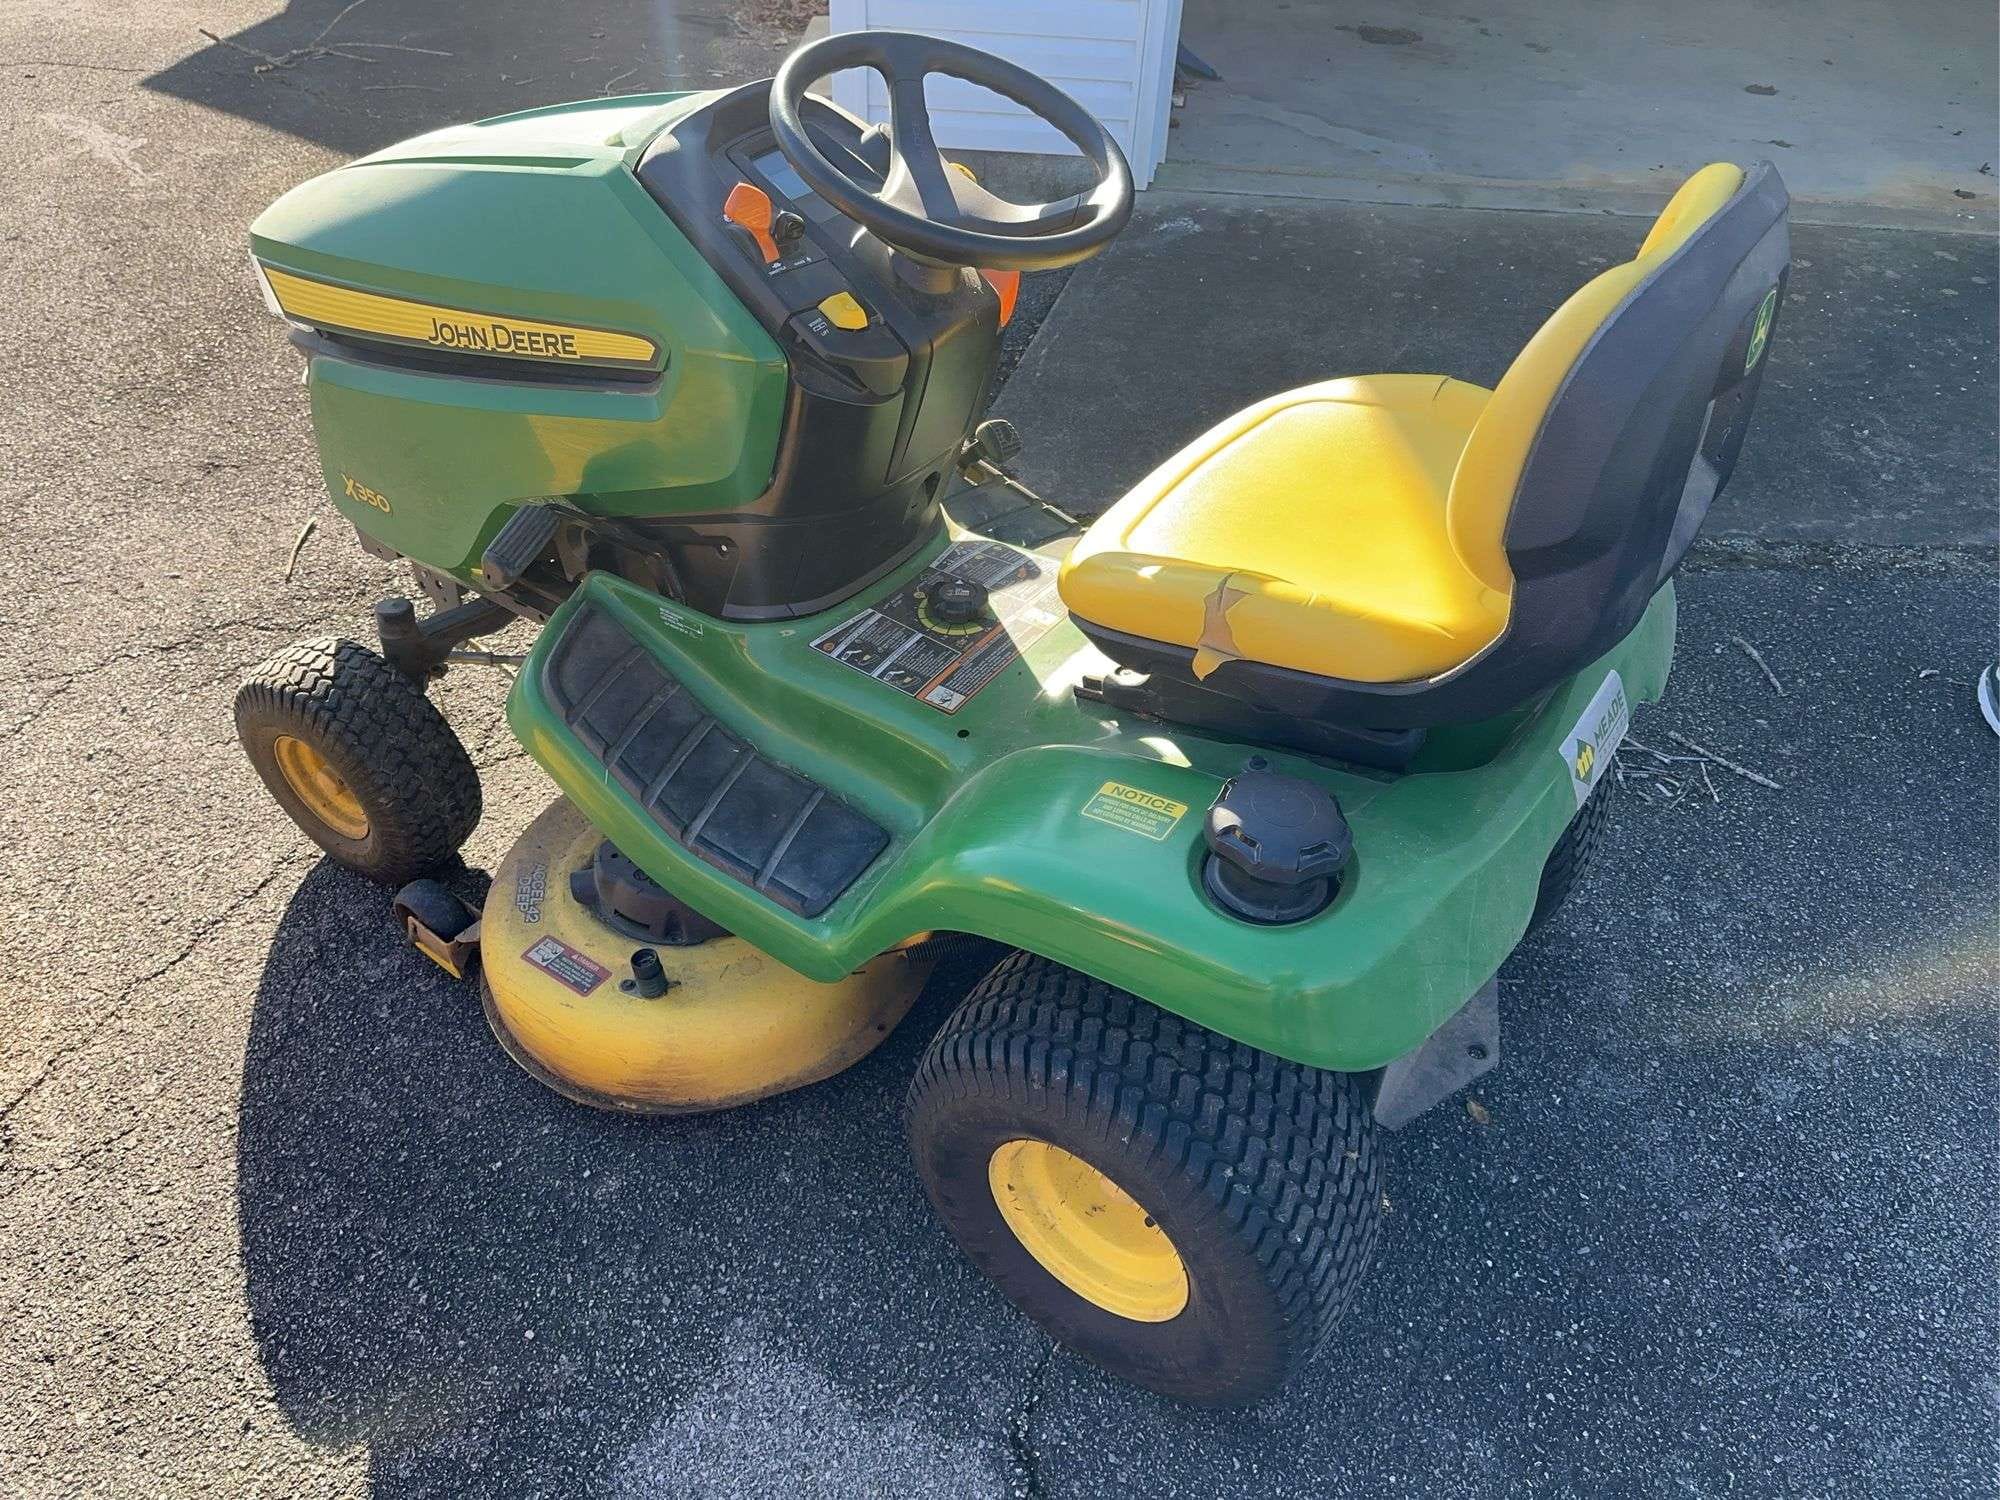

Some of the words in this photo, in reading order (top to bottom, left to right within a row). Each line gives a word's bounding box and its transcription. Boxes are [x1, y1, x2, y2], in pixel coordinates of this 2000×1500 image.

[428, 317, 490, 349] JOHN
[491, 323, 579, 357] DEERE
[341, 472, 391, 513] X350
[1592, 689, 1625, 748] MEADE
[1110, 786, 1178, 814] NOTICE
[516, 877, 531, 912] DEEP
